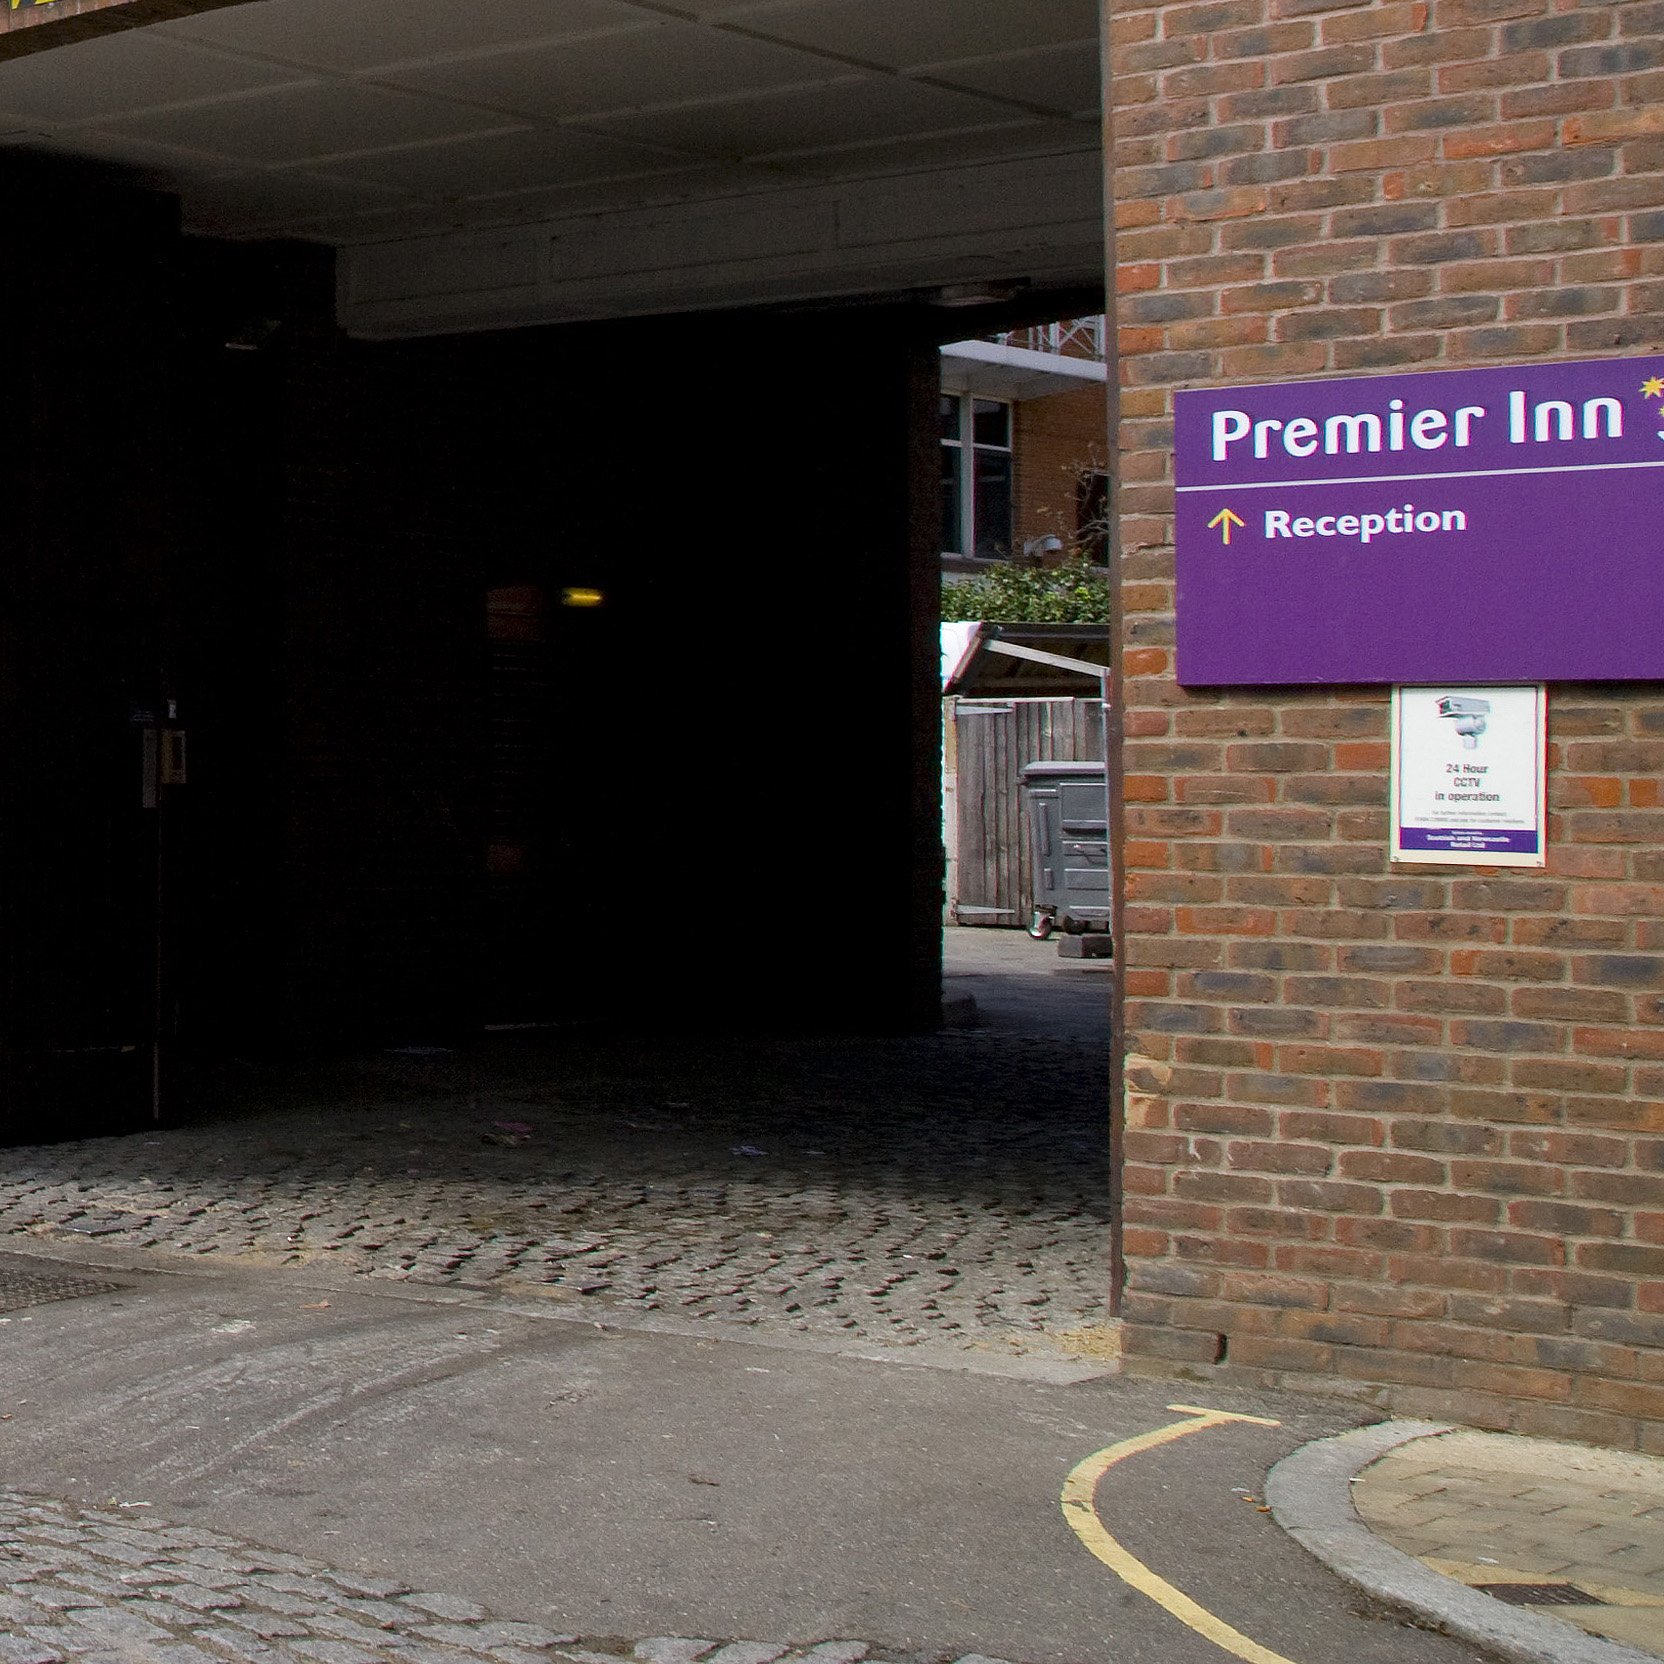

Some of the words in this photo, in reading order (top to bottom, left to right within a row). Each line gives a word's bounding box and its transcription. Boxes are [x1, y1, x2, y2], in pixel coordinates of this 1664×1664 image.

[1211, 398, 1487, 462] Premier
[1508, 390, 1623, 444] Inn
[1264, 504, 1467, 544] Reception
[1446, 763, 1460, 773] 24
[1463, 763, 1489, 773] Hour
[1453, 776, 1481, 787] CCTV
[1448, 791, 1500, 802] operation
